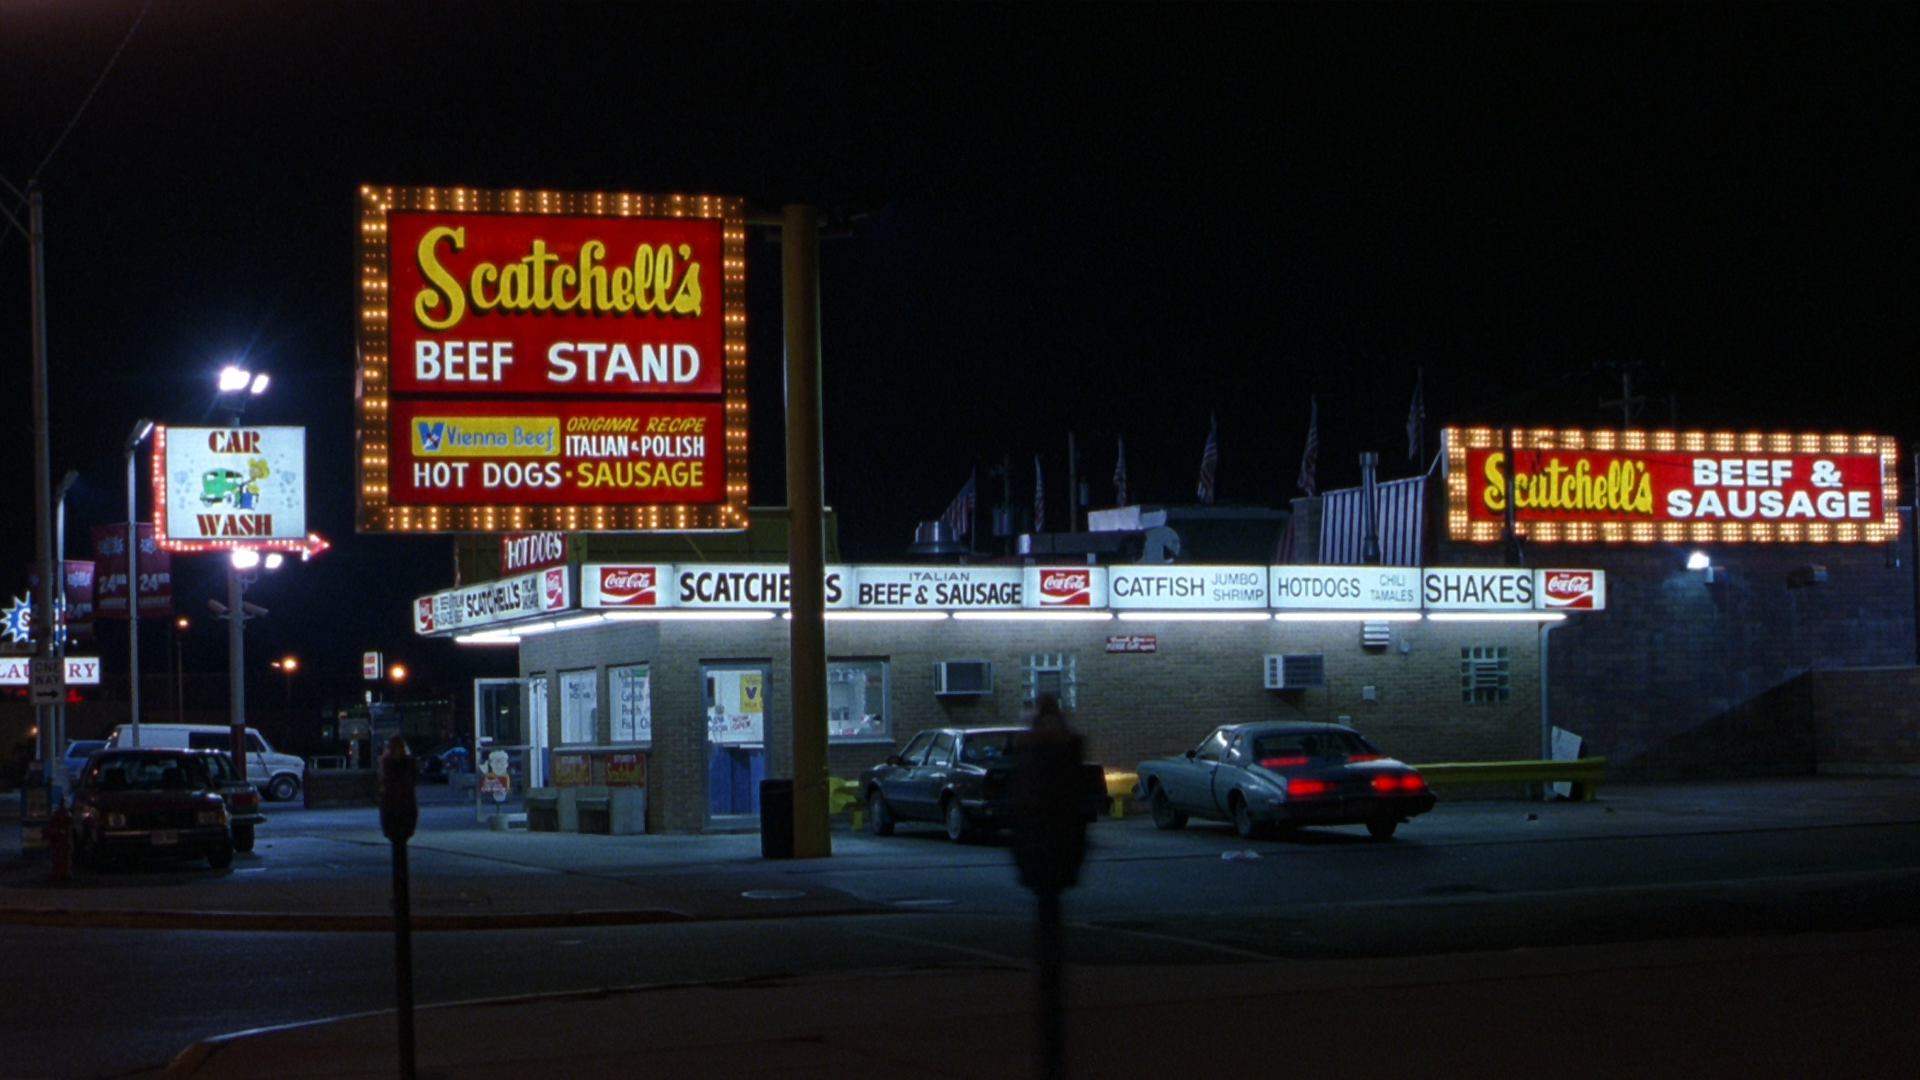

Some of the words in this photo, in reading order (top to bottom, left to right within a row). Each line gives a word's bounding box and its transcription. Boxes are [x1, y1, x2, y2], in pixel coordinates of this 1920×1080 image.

[414, 226, 702, 330] Scatchell's
[414, 341, 513, 380] BEEF
[547, 342, 701, 383] STAND
[566, 417, 638, 432] ORIGINAL
[647, 417, 706, 432] RECIPE
[208, 430, 262, 454] CAR
[446, 426, 508, 448] Vienna
[513, 426, 557, 453] Beef
[565, 435, 628, 456] ITALIAN
[641, 435, 704, 456] POLISH
[413, 462, 469, 488] HOT
[483, 462, 562, 488] DOGS
[577, 461, 703, 487] SAUSAGE
[1484, 452, 1653, 515] Scatchell's
[1693, 459, 1793, 486] BEEF
[1810, 459, 1843, 487] &
[1667, 489, 1871, 518] SAUSAGE
[196, 513, 273, 537] WASH
[508, 536, 529, 569] HOT
[530, 532, 563, 564] DOGS
[909, 572, 970, 581] ITALIAN
[1113, 576, 1204, 597] CATFISH
[1211, 573, 1259, 585] JUMBO
[1278, 577, 1361, 598] HOTDOGS
[1379, 574, 1405, 587] CHILI
[466, 580, 521, 618] SCATCHELL'S
[859, 583, 912, 605] BEEF
[914, 585, 928, 605] &
[935, 583, 1022, 605] SAUSAGE
[1213, 589, 1264, 602] SHRIMP
[1370, 589, 1414, 602] TAMALES
[1425, 574, 1532, 603] SHAKES
[35, 661, 60, 673] ONE
[35, 675, 60, 685] WAY
